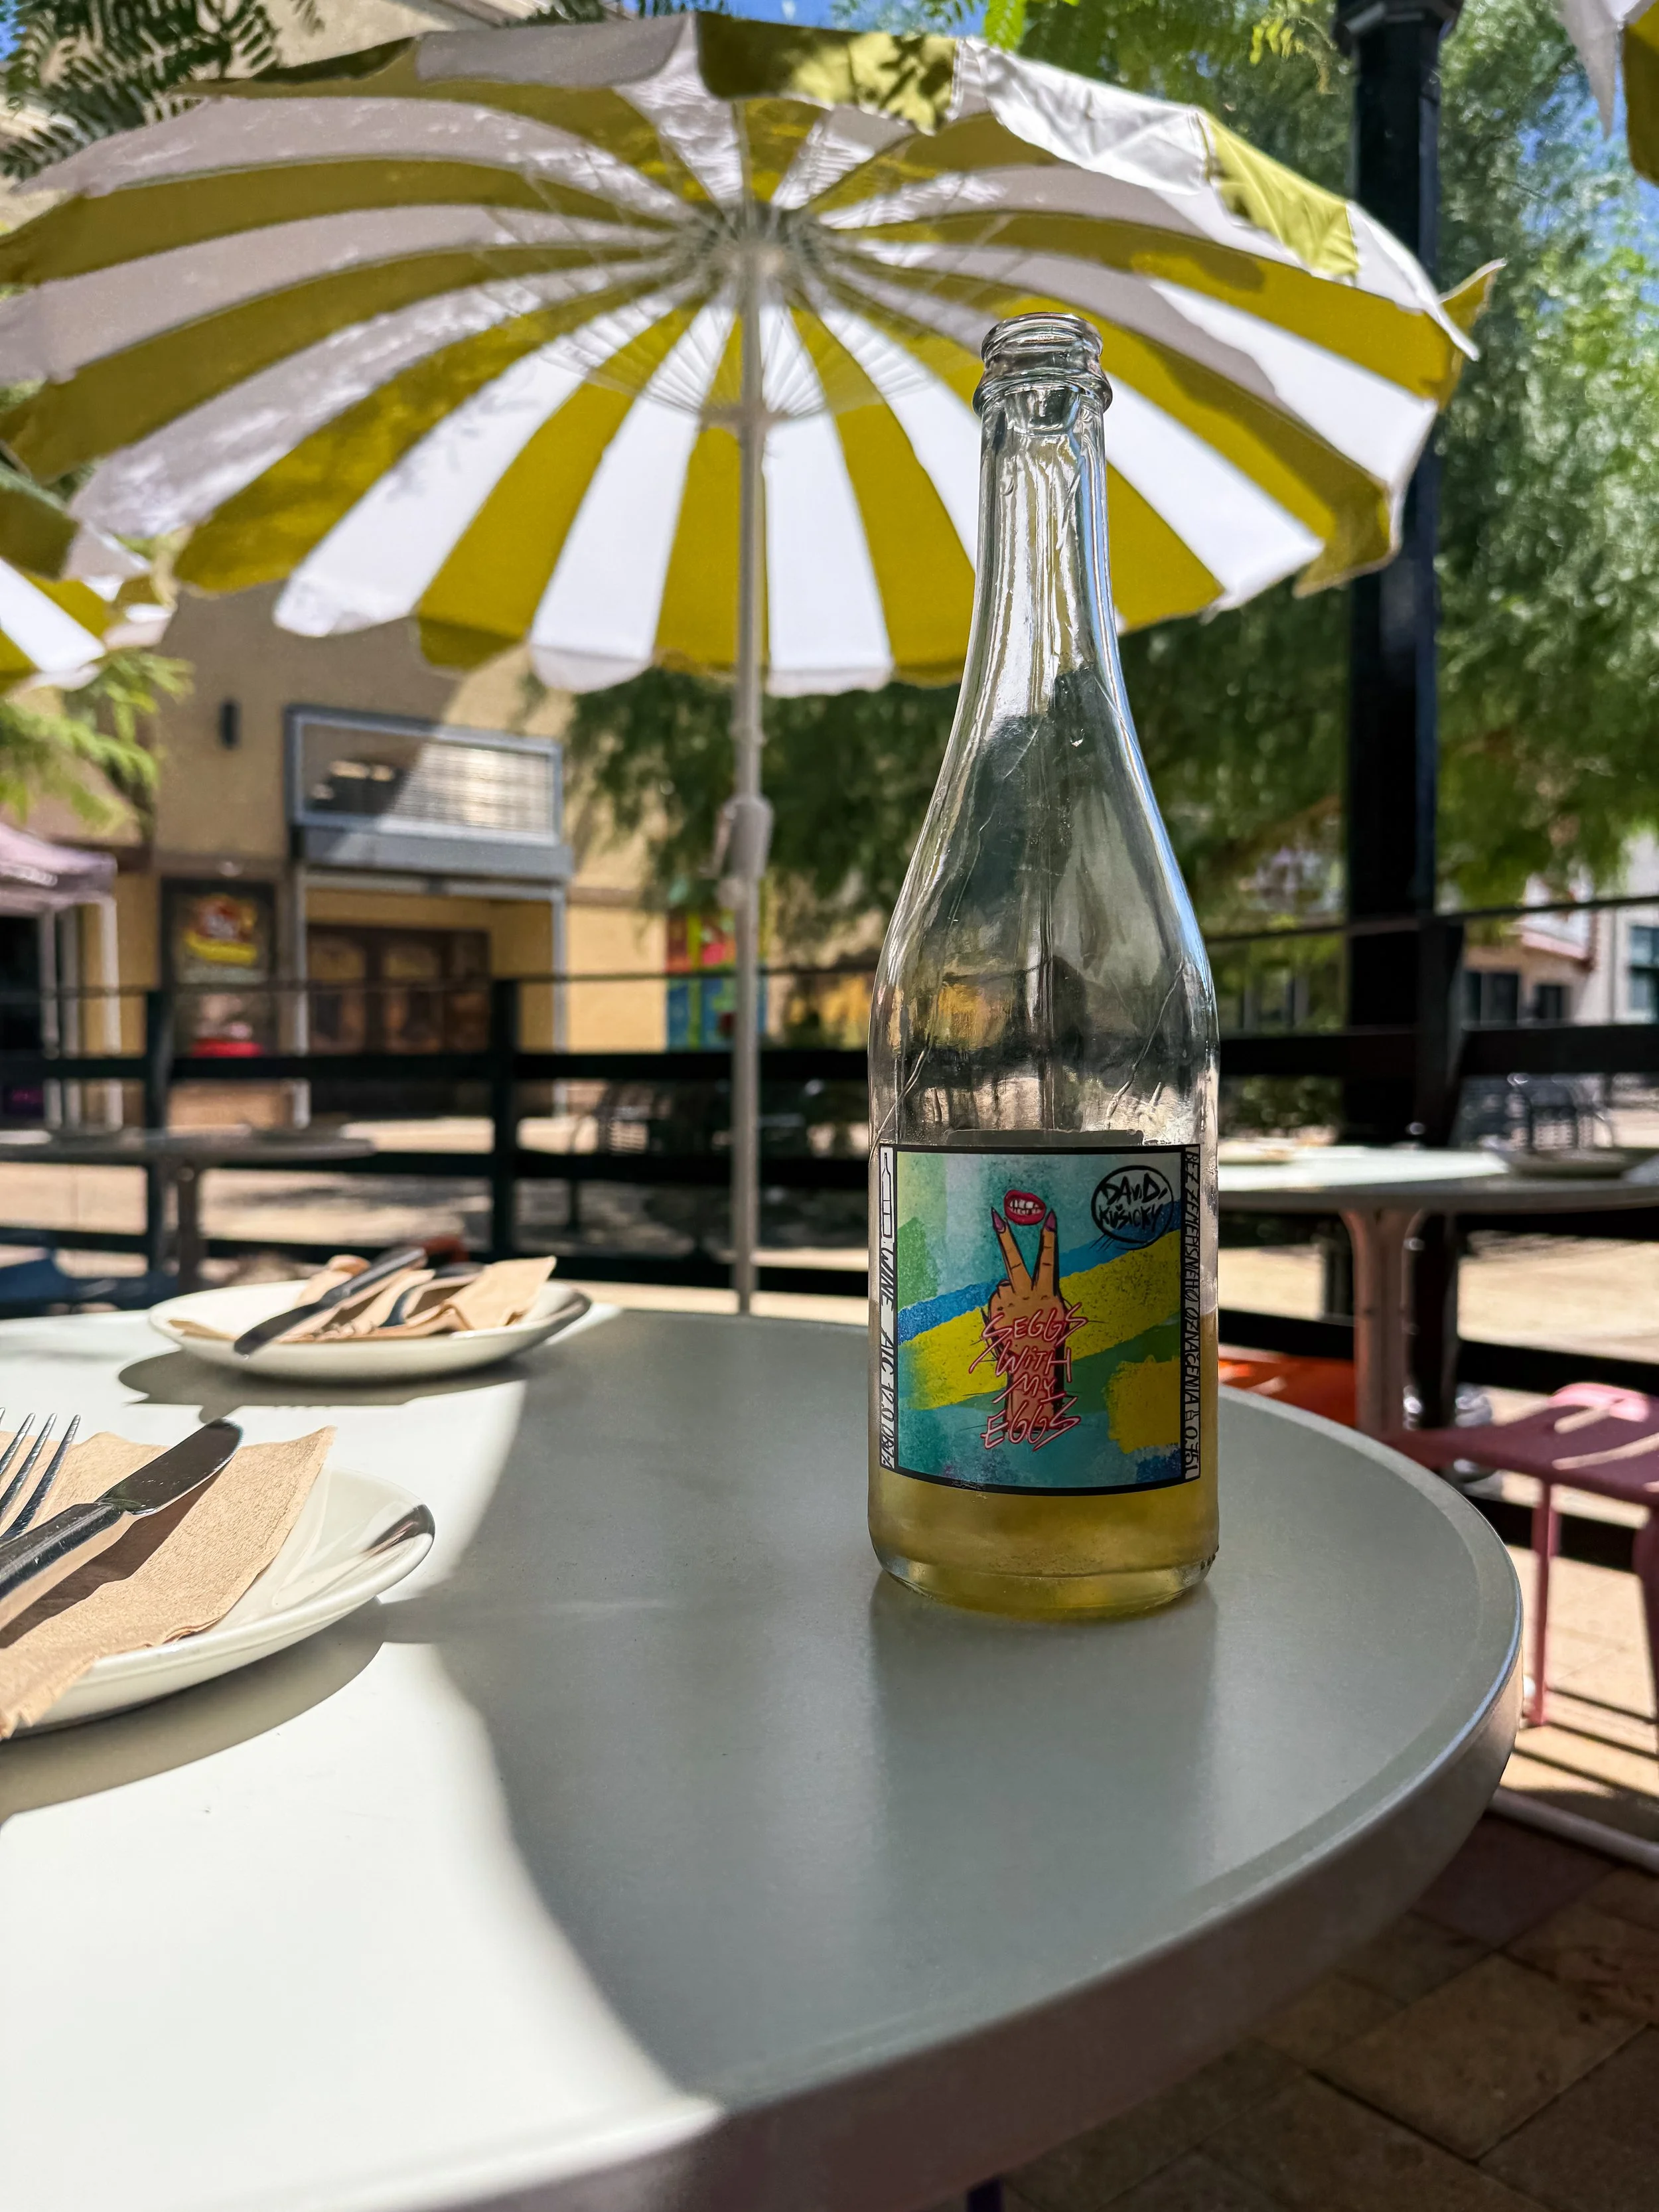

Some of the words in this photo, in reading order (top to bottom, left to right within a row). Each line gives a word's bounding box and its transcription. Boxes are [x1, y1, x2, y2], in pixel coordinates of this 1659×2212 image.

[1101, 1172, 1161, 1205] DAVID
[1185, 1151, 1200, 1185] BEZ
[880, 1247, 895, 1312] WINE
[969, 1302, 1089, 1374] SEGGS
[992, 1372, 1067, 1404] MY
[980, 1396, 1082, 1452] EGGS
